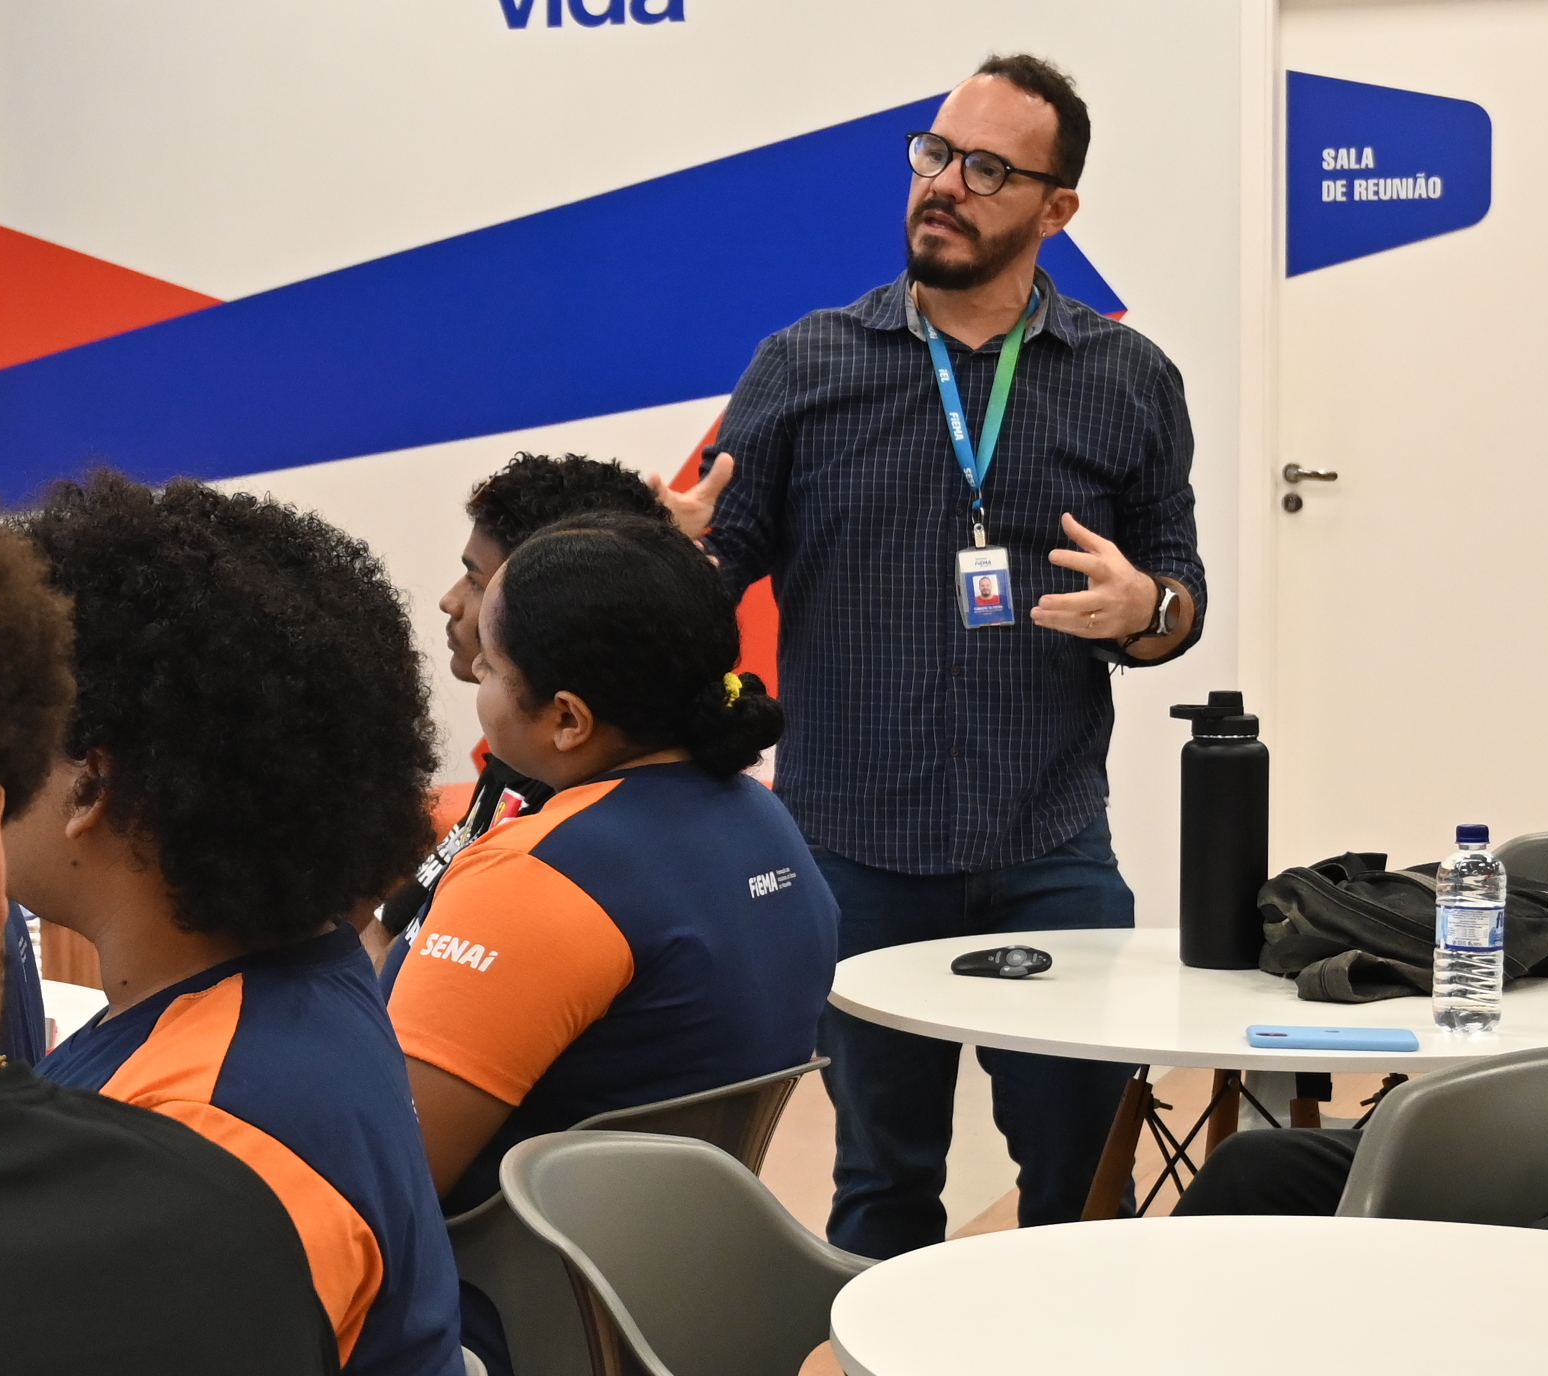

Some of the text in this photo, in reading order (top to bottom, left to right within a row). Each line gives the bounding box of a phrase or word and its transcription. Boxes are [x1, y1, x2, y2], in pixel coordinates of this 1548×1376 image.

[1322, 147, 1374, 170] SALA
[1322, 172, 1443, 202] DE REUNIÃO
